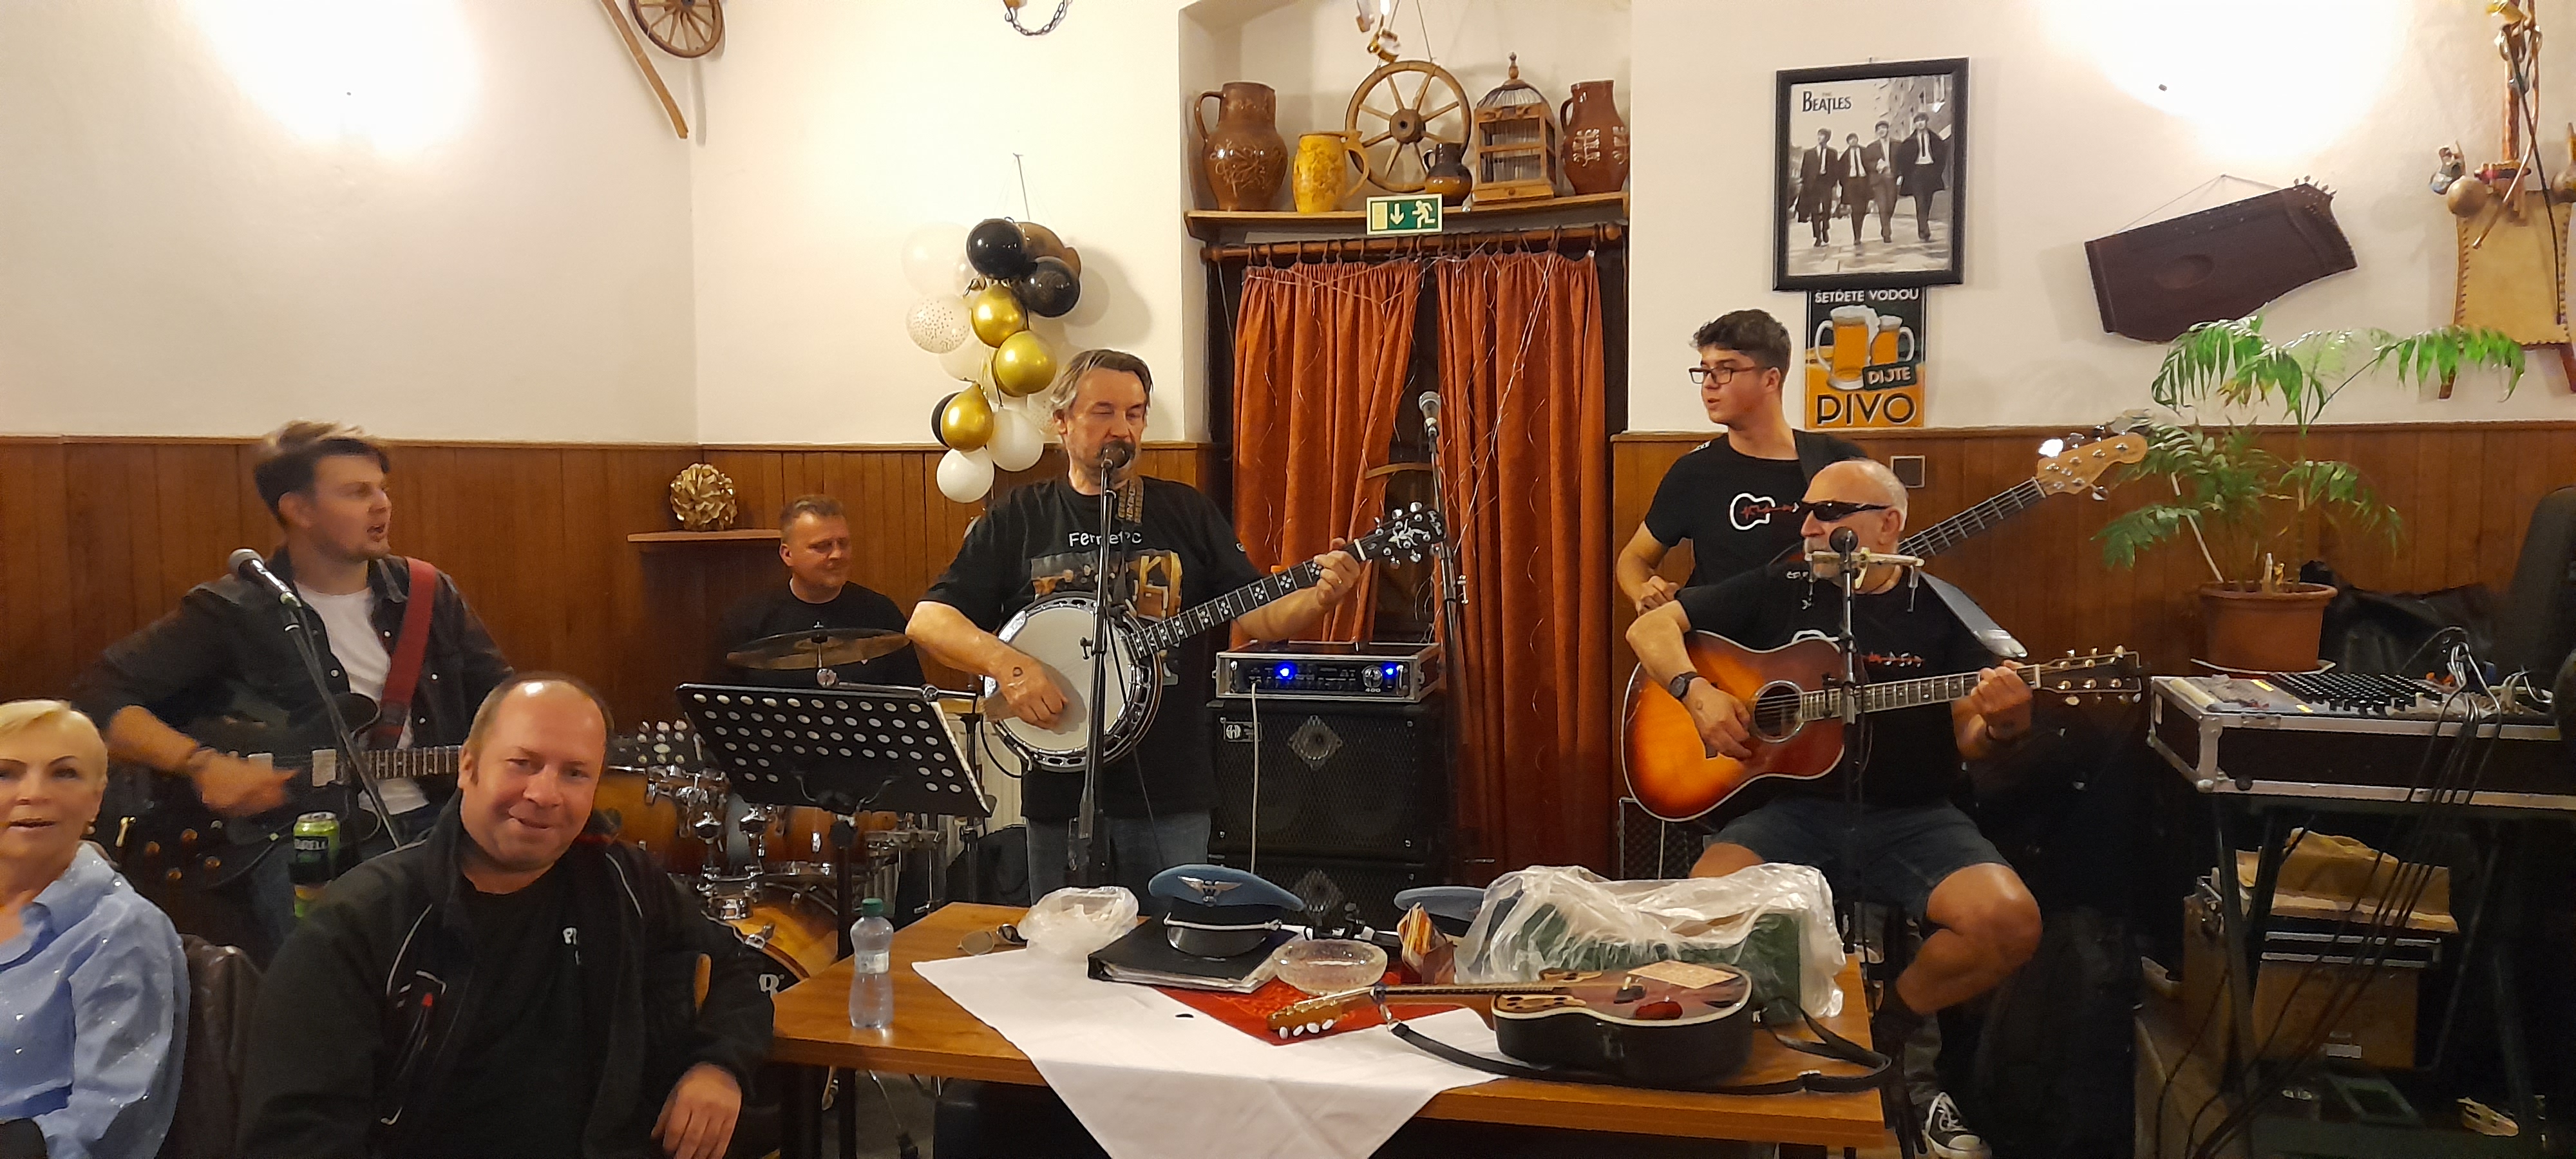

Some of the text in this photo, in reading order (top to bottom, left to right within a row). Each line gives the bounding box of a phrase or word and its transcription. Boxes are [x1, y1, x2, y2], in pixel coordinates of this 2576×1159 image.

[1803, 91, 1852, 114] BEATLES
[1869, 288, 1918, 301] VODOU
[1817, 393, 1917, 426] PIVO
